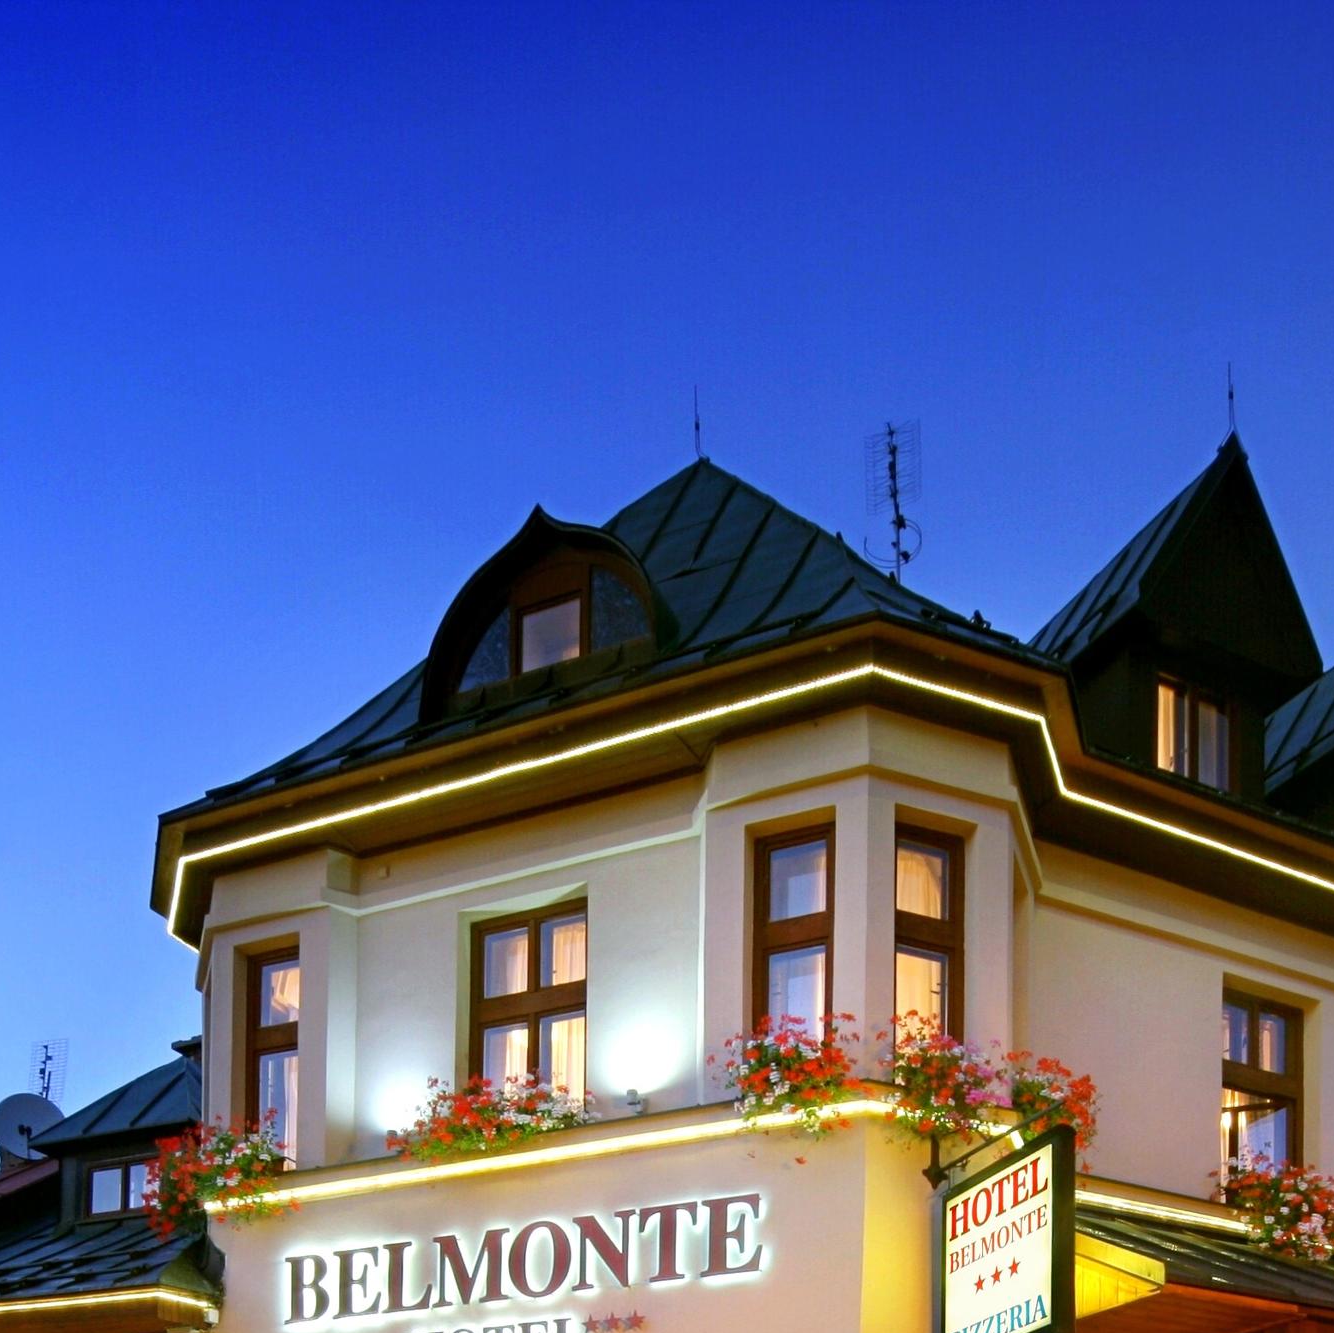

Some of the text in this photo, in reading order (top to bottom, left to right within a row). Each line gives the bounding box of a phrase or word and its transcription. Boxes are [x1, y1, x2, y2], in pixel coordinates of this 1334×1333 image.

[949, 1157, 1048, 1242] HOTEL
[949, 1204, 1048, 1274] BELMONTE
[284, 1193, 764, 1325] BELMONTE
